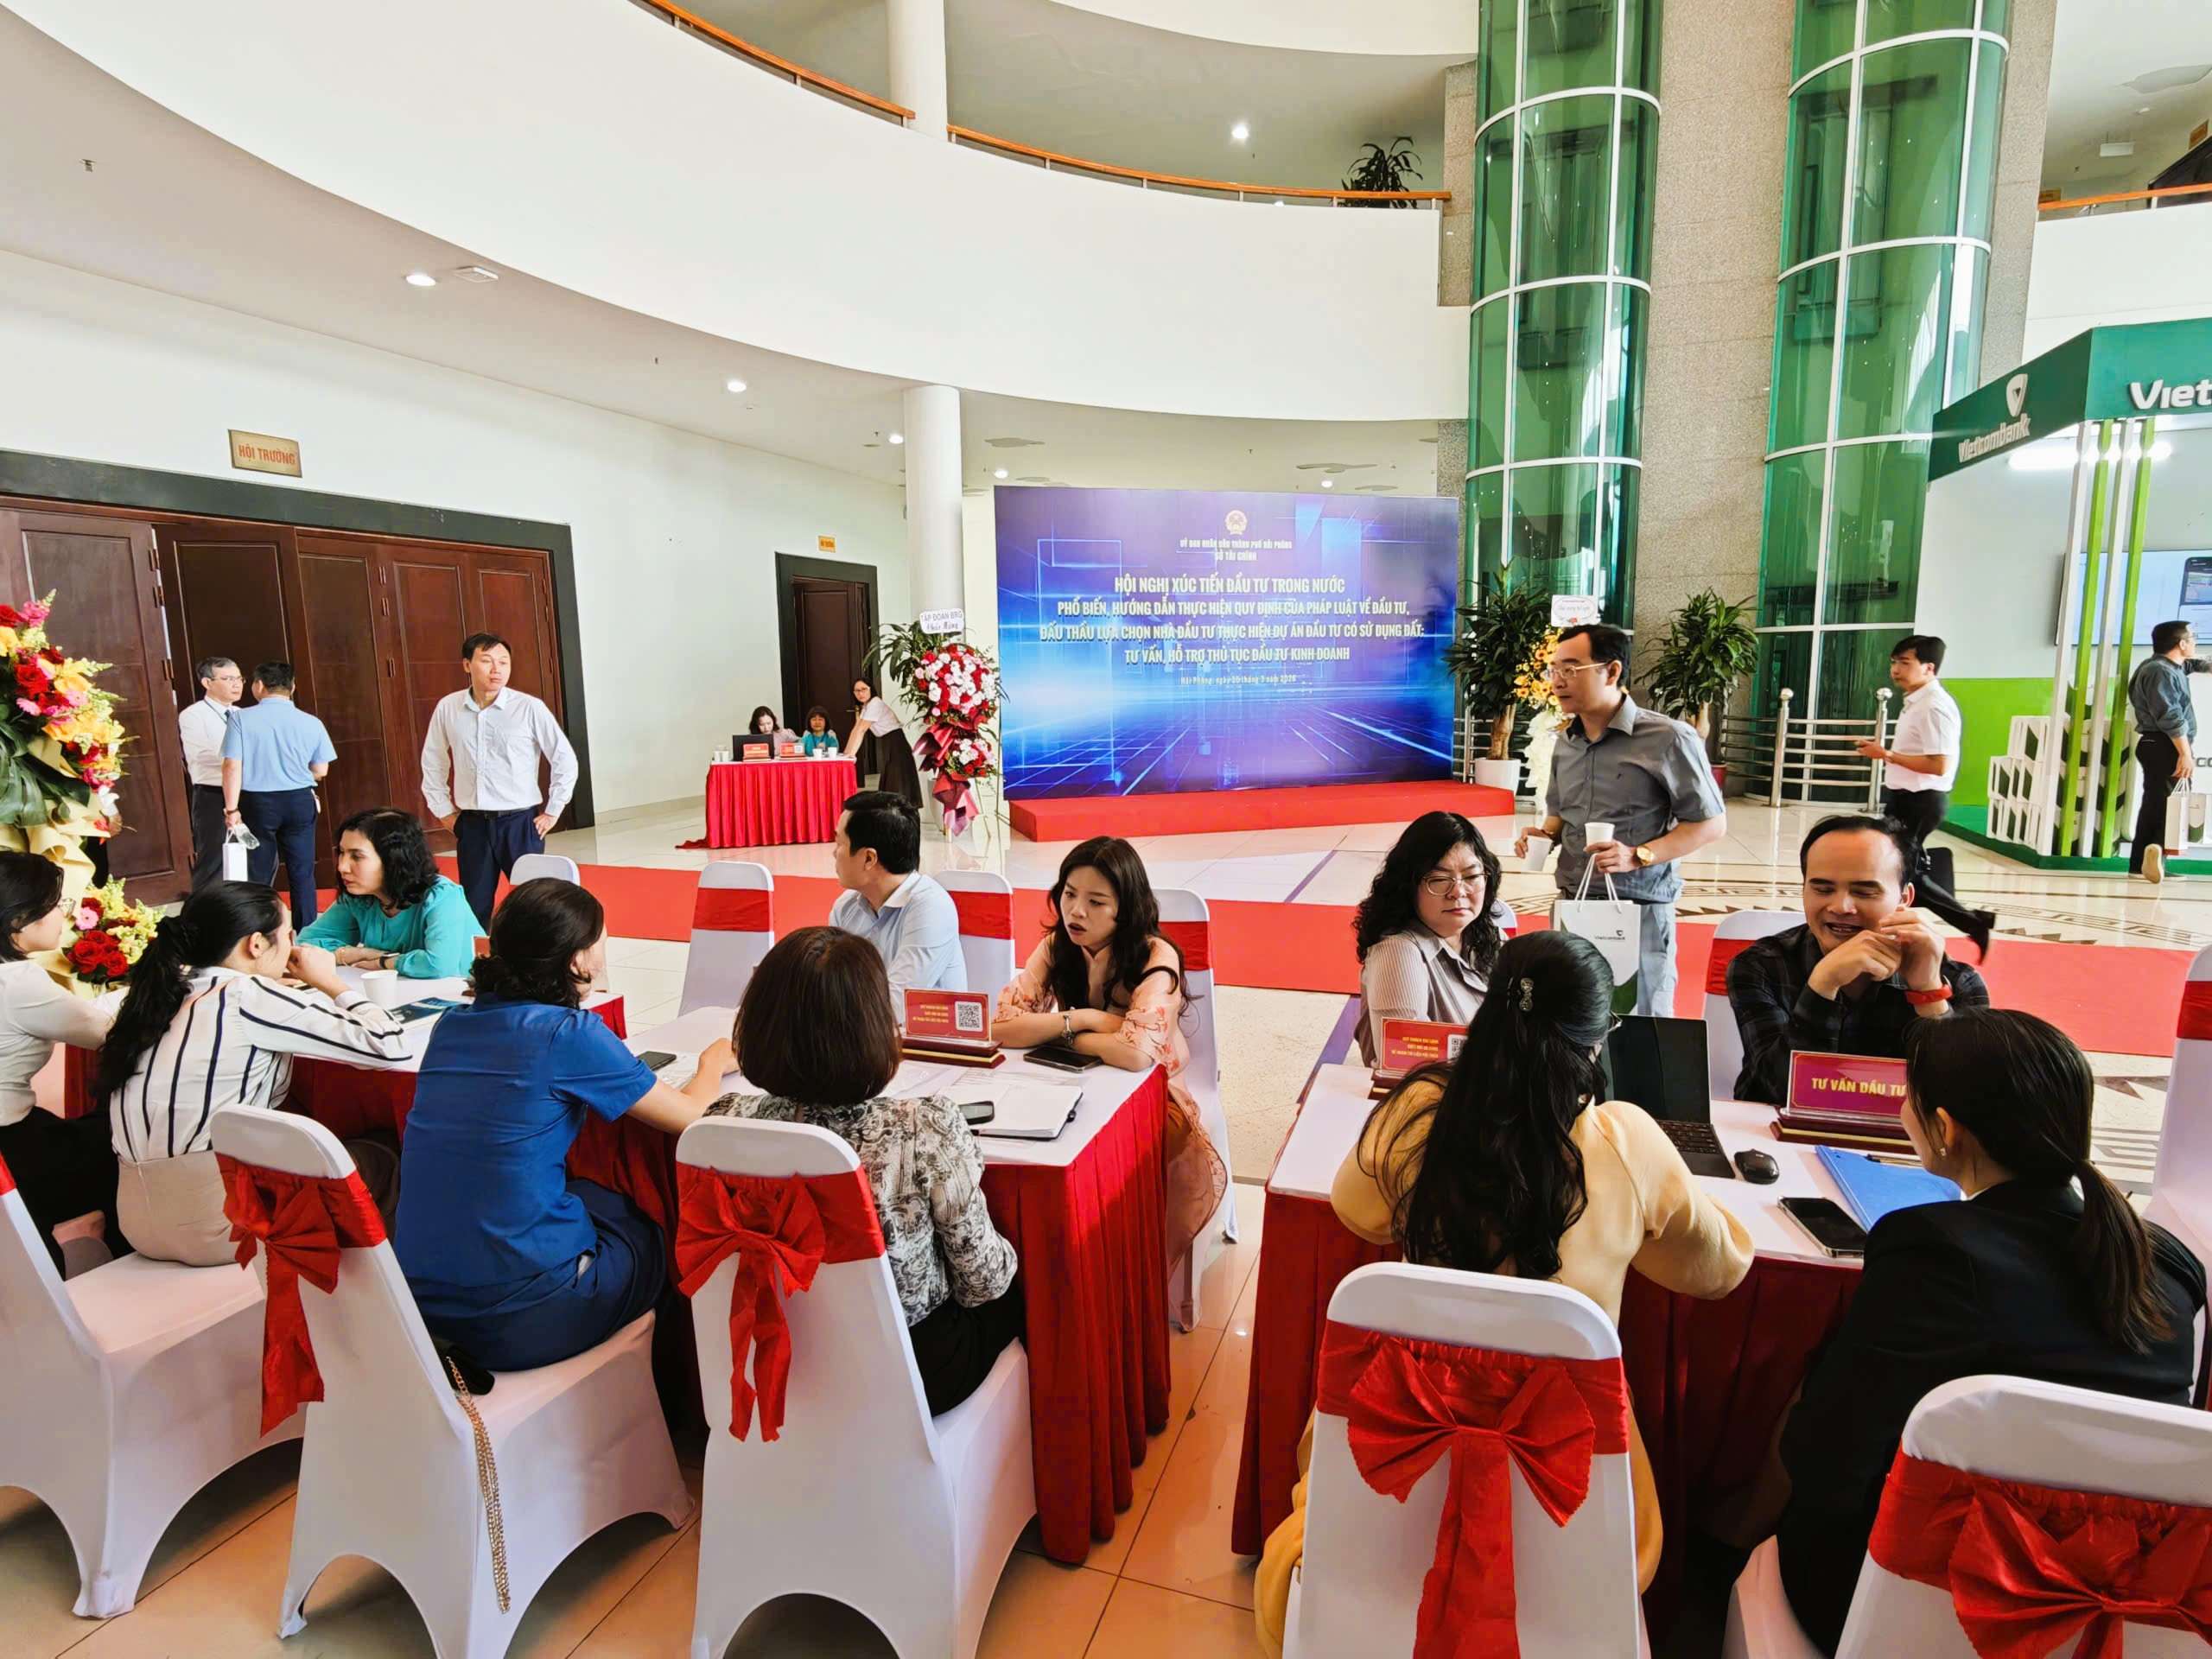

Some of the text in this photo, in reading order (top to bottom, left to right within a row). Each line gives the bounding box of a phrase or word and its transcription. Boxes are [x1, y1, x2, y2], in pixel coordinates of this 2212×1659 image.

[2131, 378, 2212, 410] Viet
[1959, 413, 2031, 462] Vietcombank
[238, 443, 296, 465] HỘI TRƯỜNG
[1115, 572, 1345, 595] HỘI NGHỊ XÚC TIẾN ĐẦU TƯ TRONG NƯỚC
[1058, 595, 1410, 618] PHỔ BIẾN, HƯỚNG DẪN THỰC HIỆN QUY ĐỊNH CỦA PHÁP LUẬT VỀ ĐẦU TƯ,
[1039, 622, 1063, 640] ĐẤU
[1066, 621, 1093, 640] THẦU
[1097, 626, 1119, 643] LỰA
[1121, 626, 1151, 643] CHỌN
[1154, 622, 1175, 639] NHÀ
[1177, 620, 1198, 639] ĐẦU
[1201, 625, 1216, 639] TƯ
[1217, 625, 1246, 641] THỰC
[1248, 622, 1270, 641] HIỆN
[1272, 625, 1288, 640] DỰ
[1291, 621, 1304, 638] ÁN
[1306, 620, 1325, 638] ĐẦU
[1328, 625, 1342, 638] TƯ
[1344, 621, 1357, 638] CÓ
[1359, 620, 1374, 638] SỬ
[1376, 624, 1402, 639] DỤNG
[1125, 649, 1141, 664] TƯ
[1168, 644, 1182, 664] HỖ
[1185, 649, 1205, 665] TRỢ
[1208, 645, 1228, 663] THỦ
[1230, 648, 1250, 664] TỤC
[1252, 643, 1273, 661] ĐẦU
[1274, 648, 1289, 661] TƯ
[1291, 647, 1314, 661] KINH
[1316, 647, 1350, 661] DOANH
[1811, 1077, 1906, 1097] TƯ VẤN ĐẦU TƯ
